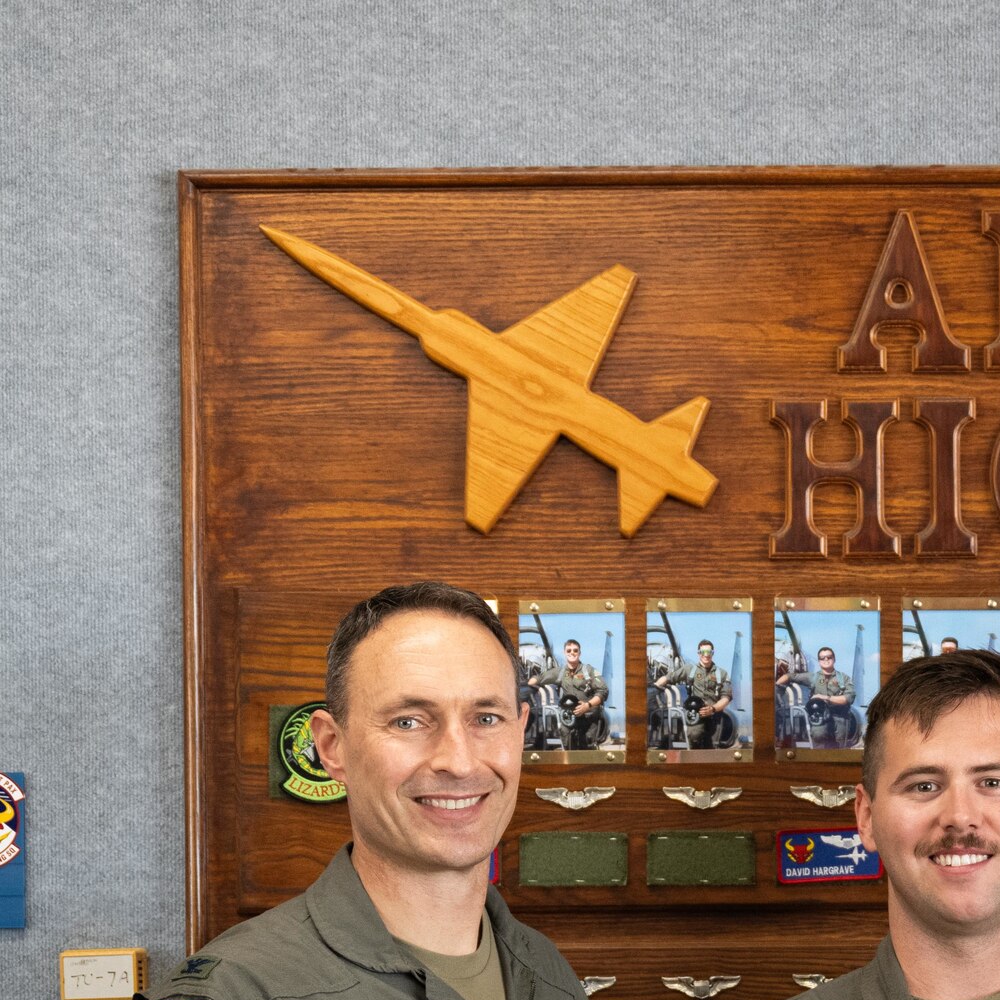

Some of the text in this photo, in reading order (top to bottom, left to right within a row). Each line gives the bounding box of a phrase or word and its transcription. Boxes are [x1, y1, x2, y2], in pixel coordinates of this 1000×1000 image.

[3, 779, 18, 795] PAX
[785, 865, 855, 877] DAVID HARGRAVE
